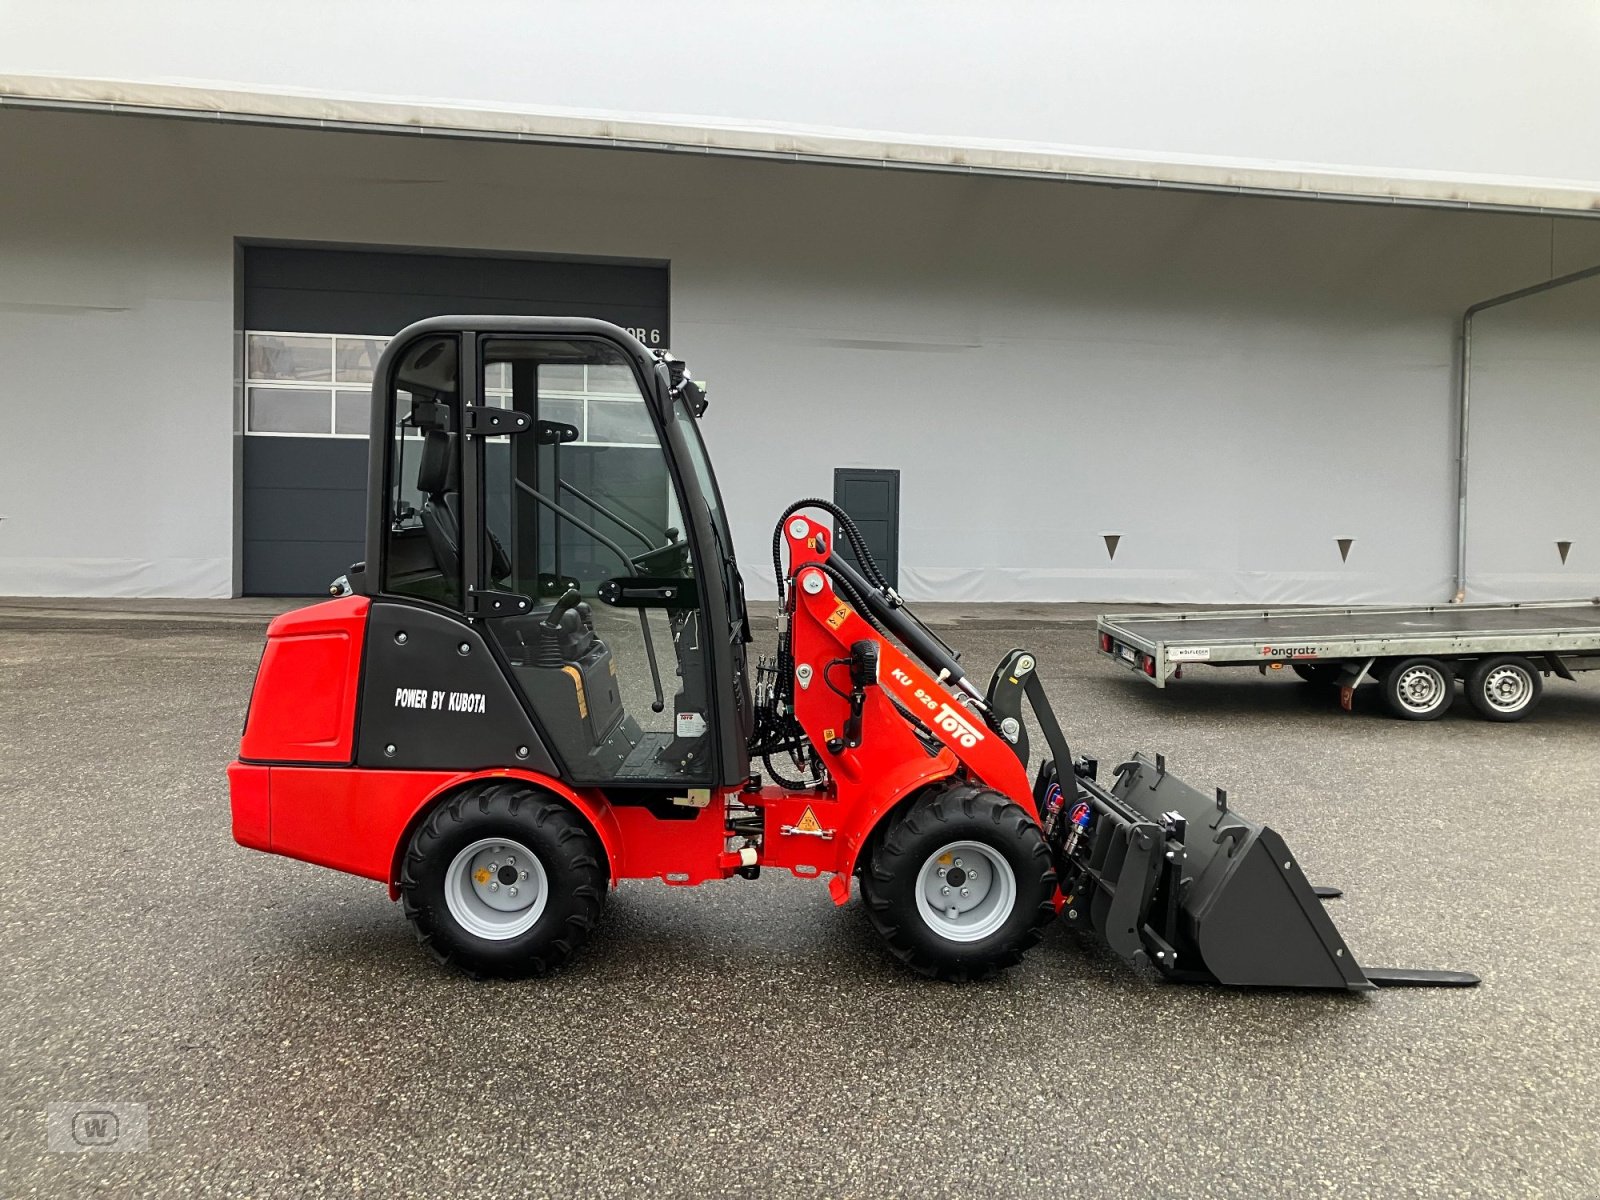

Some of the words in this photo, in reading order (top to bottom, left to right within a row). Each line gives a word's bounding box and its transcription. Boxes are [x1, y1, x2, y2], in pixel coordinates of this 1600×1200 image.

[650, 329, 660, 344] 6
[1263, 646, 1317, 658] Pongratz
[395, 688, 428, 709] POWER
[430, 691, 446, 710] BY
[448, 692, 486, 713] KUBOTA
[891, 668, 913, 686] KU
[914, 689, 938, 710] 926
[934, 703, 985, 748] TOYO
